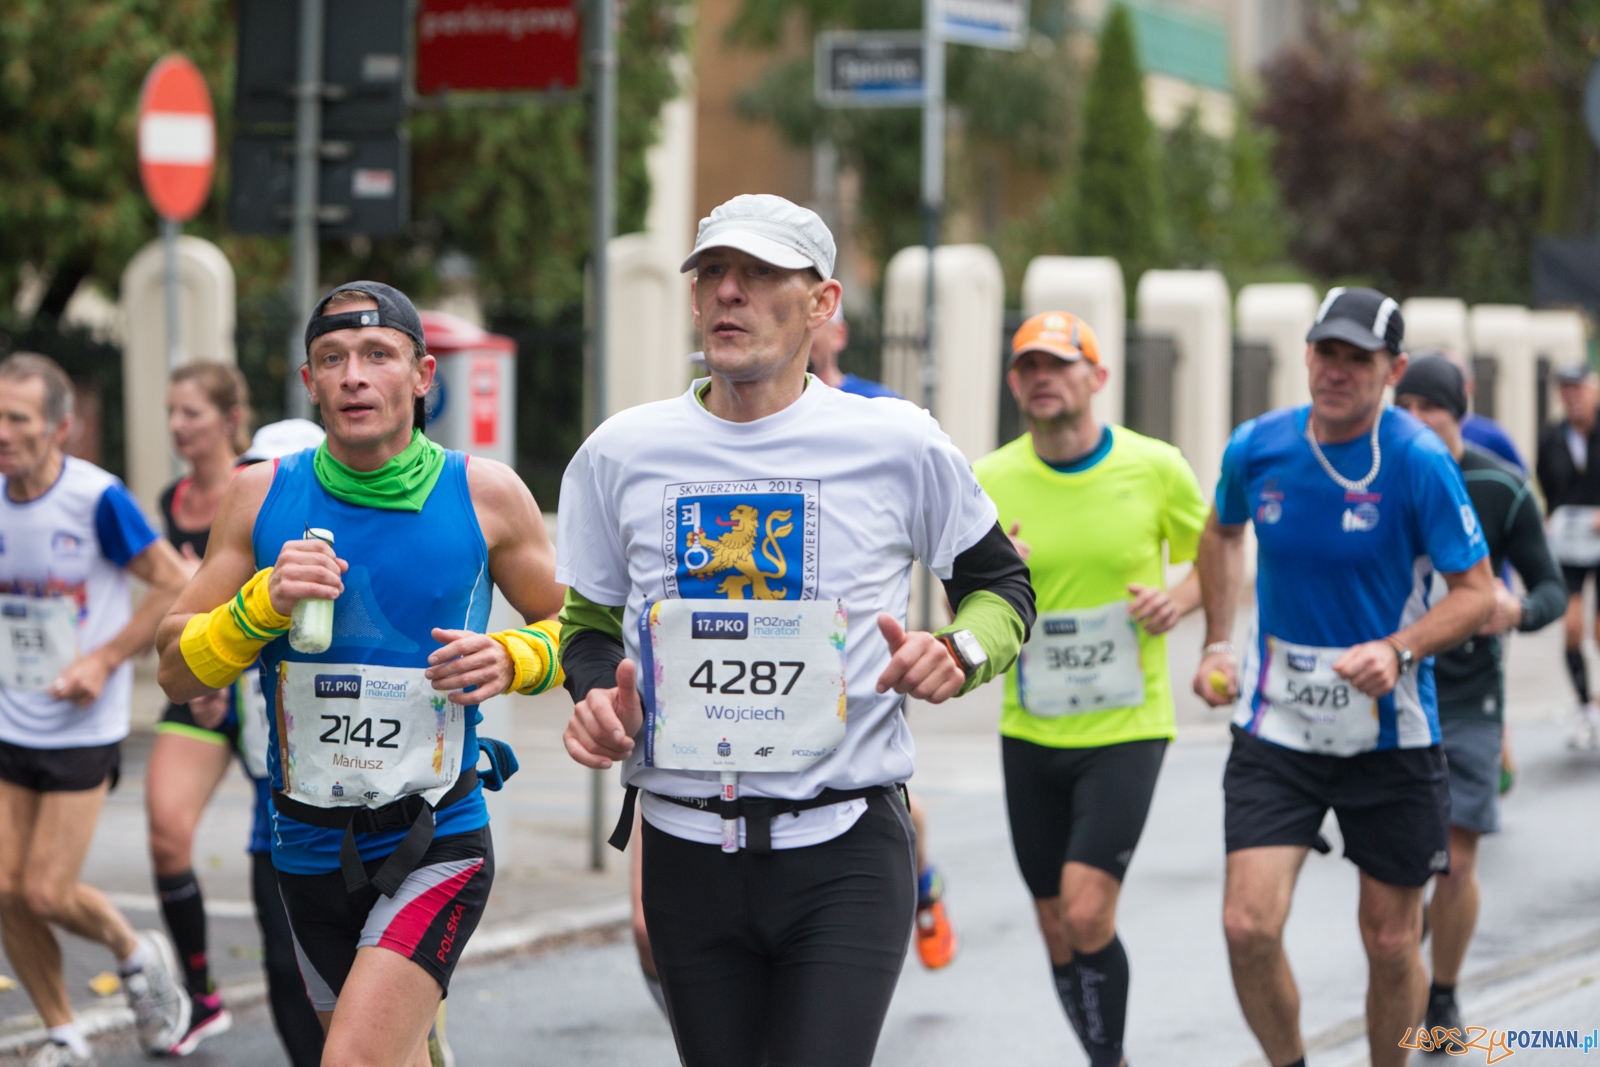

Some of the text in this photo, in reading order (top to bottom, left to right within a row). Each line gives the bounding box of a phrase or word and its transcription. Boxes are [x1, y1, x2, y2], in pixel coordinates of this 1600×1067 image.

[421, 5, 576, 43] parkingowy
[679, 480, 803, 496] SKWIERZYNA 2015
[665, 504, 678, 597] WOODWASTE
[805, 493, 816, 581] SKWIERZYNY
[753, 626, 800, 636] maraton
[1045, 640, 1116, 670] 3622
[689, 659, 806, 695] 4287
[365, 689, 406, 698] maraton
[1285, 679, 1350, 709] 5478
[704, 705, 785, 723] Wojciech
[319, 714, 401, 749] 2142
[332, 753, 384, 770] Mariusz
[754, 747, 775, 757] 4F
[363, 791, 379, 800] 4F
[436, 903, 466, 963] POLSKA
